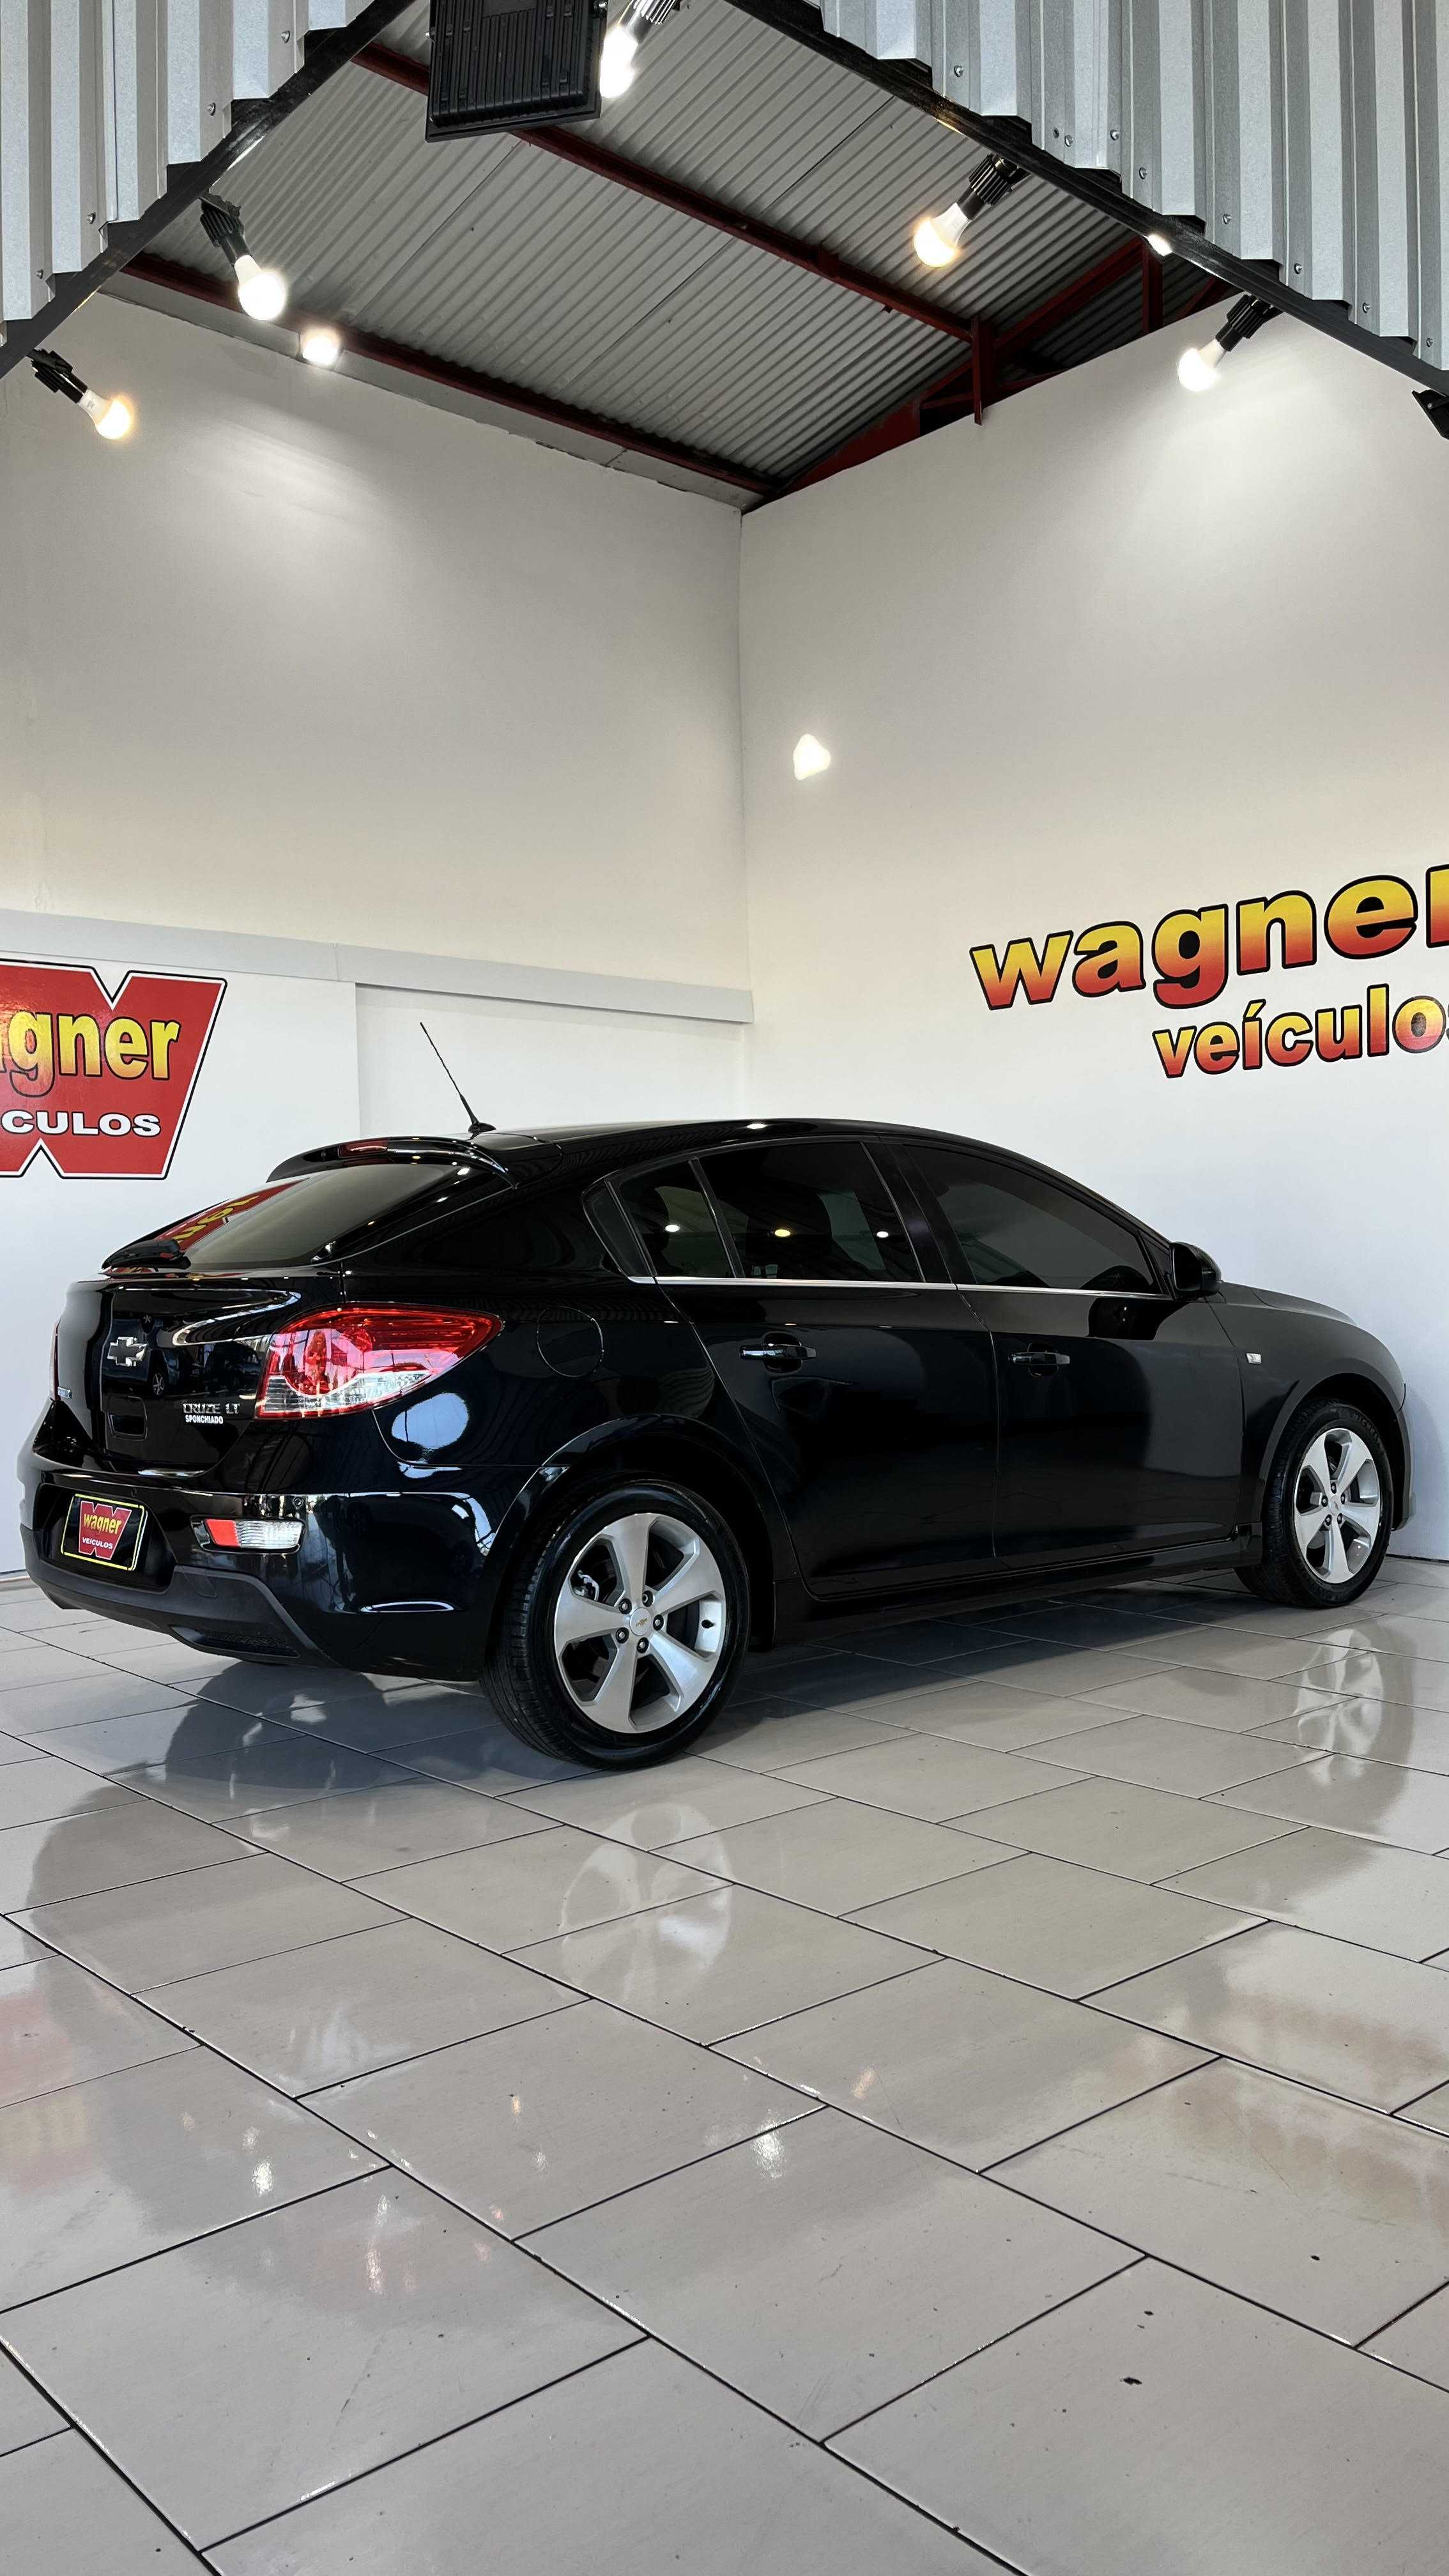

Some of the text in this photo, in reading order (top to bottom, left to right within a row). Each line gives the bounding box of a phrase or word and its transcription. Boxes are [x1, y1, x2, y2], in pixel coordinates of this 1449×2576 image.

[1153, 983, 1449, 1078] veículo
[0, 1010, 181, 1098] gner
[183, 1403, 241, 1414] CRUZE LT
[185, 1414, 224, 1425] SPONCHIADO
[82, 1514, 122, 1535] wagner
[82, 1537, 113, 1549] VEÍCULOS
